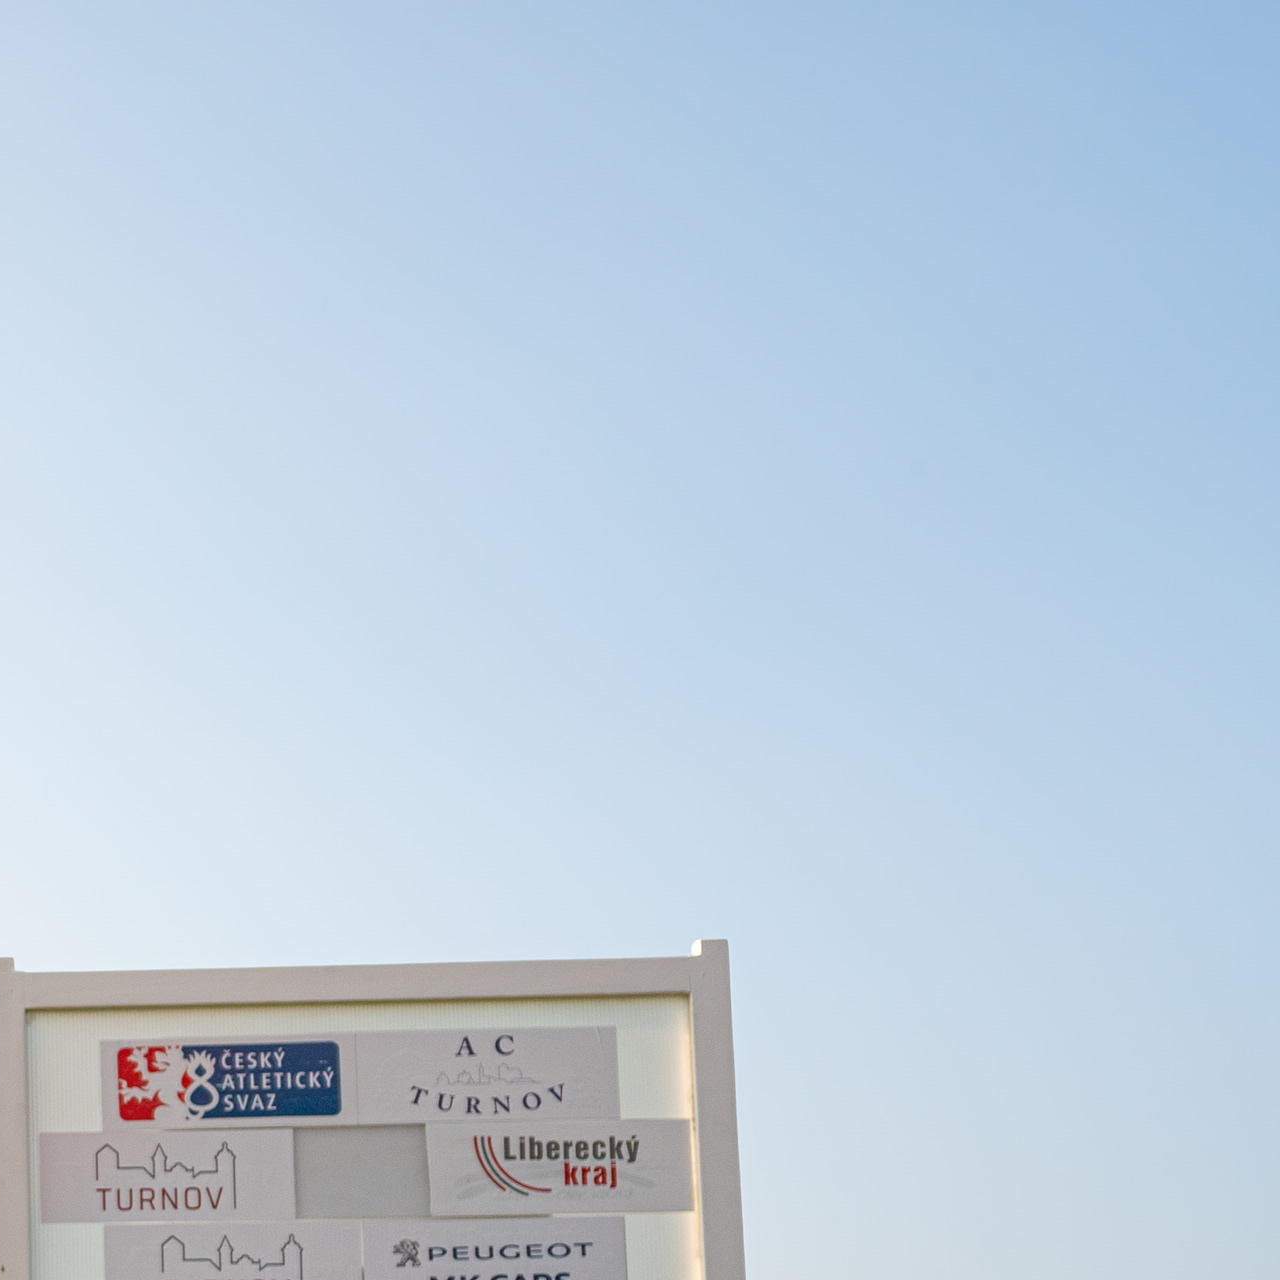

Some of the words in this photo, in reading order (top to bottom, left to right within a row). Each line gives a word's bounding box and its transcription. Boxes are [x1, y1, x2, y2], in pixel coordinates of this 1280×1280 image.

[220, 1048, 286, 1070] ČESKÝ
[219, 1066, 335, 1091] ATLETICKÝ
[222, 1091, 278, 1113] SVAZ
[410, 1083, 566, 1115] TURNOV
[503, 1135, 640, 1162] Liberecký
[563, 1161, 618, 1189] kraj
[96, 1186, 224, 1212] TURNOV
[427, 1242, 594, 1261] PEUGEOT
